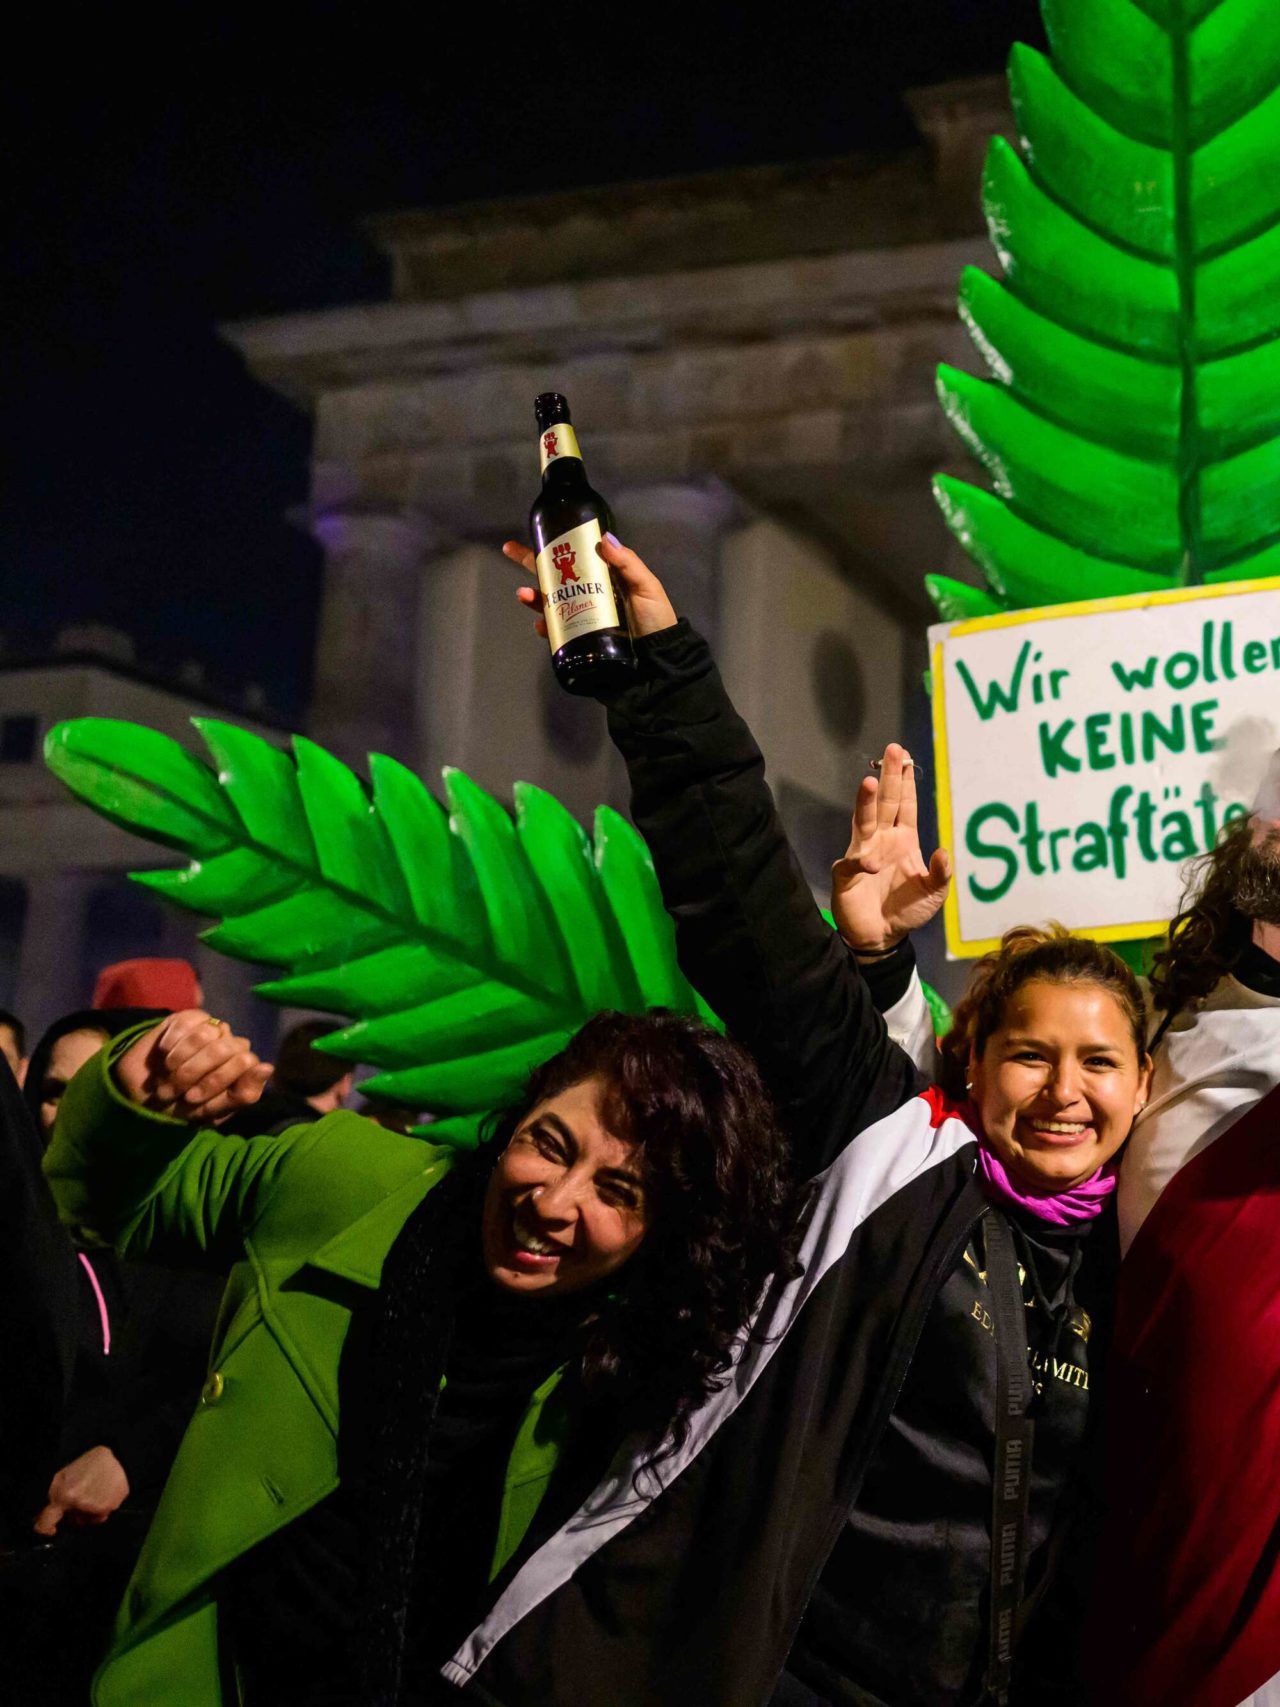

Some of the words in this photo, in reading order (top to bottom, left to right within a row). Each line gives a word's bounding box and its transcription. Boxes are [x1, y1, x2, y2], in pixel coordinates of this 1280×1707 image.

[556, 600, 594, 620] Pilsner
[955, 640, 1070, 721] Wir
[1038, 700, 1220, 778] KEINE
[964, 781, 1248, 903] Straftäte
[1003, 1439, 1023, 1501] PUMA
